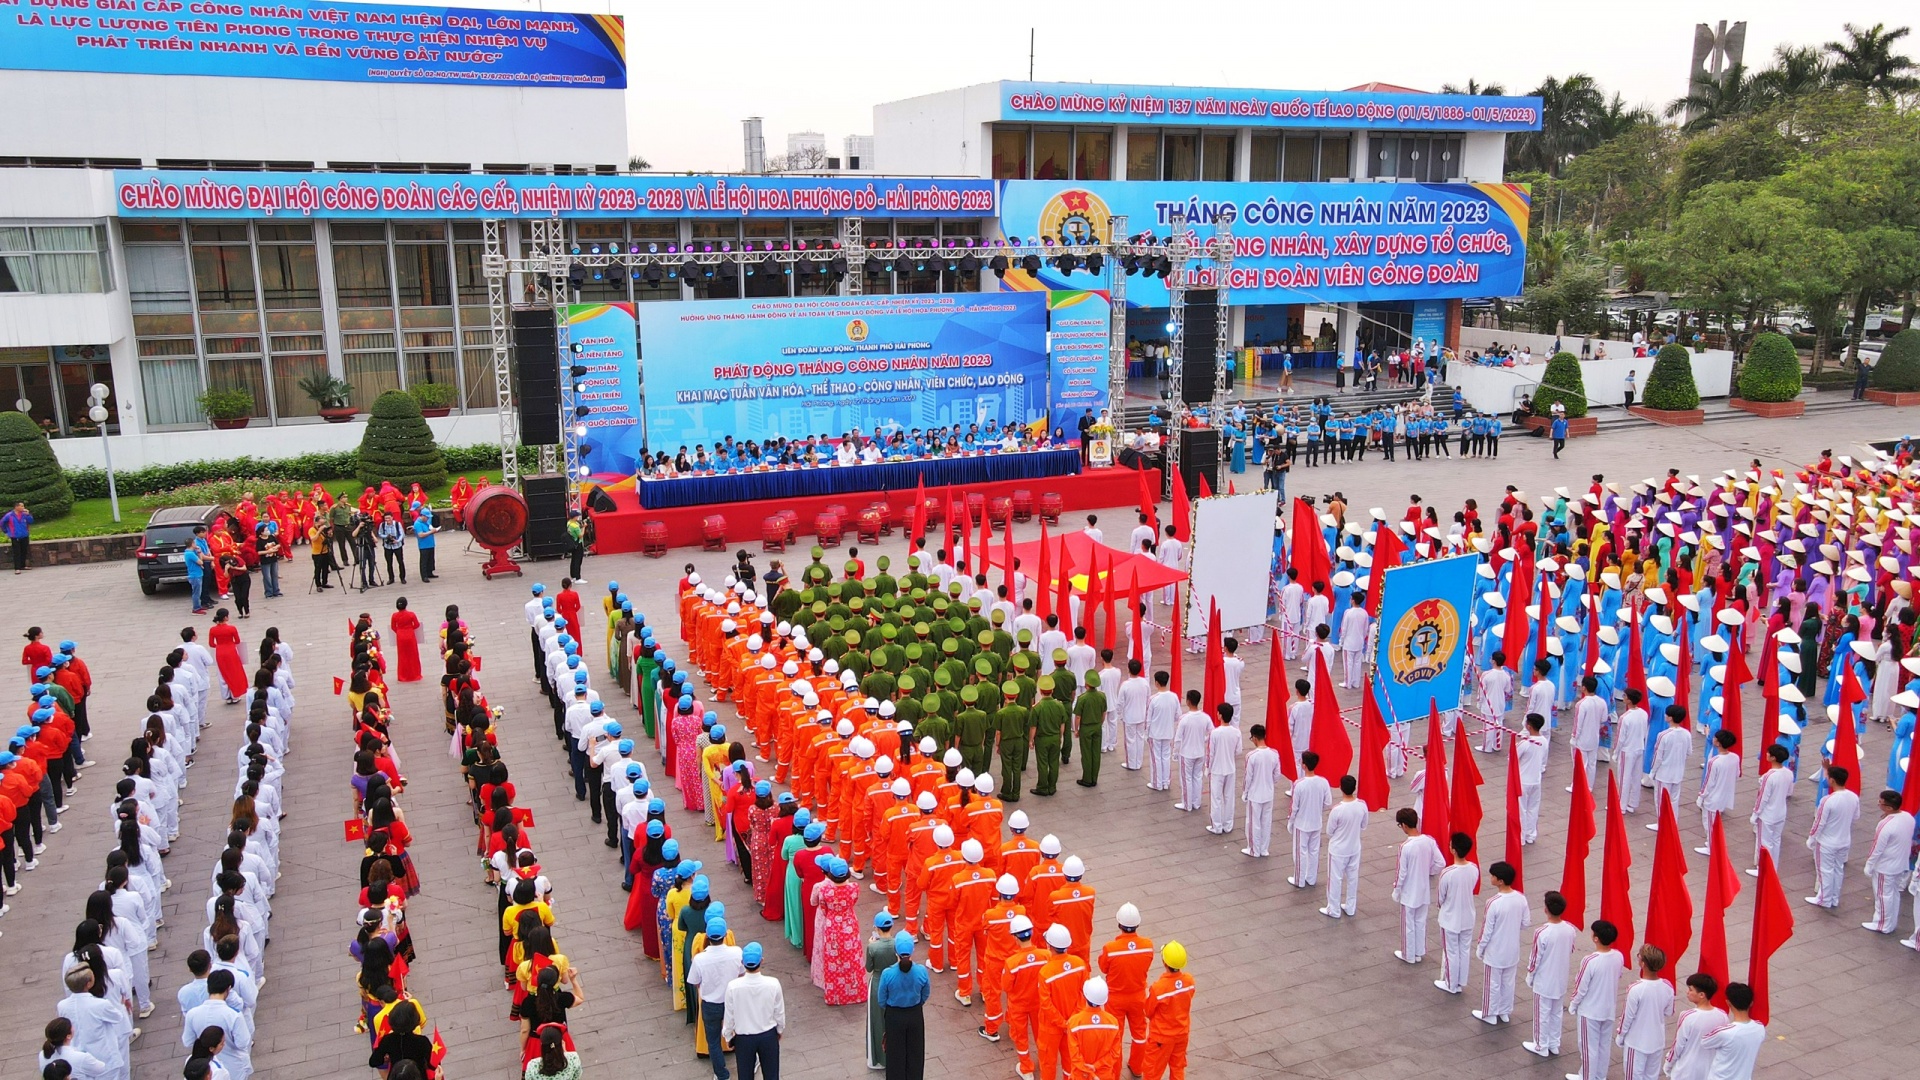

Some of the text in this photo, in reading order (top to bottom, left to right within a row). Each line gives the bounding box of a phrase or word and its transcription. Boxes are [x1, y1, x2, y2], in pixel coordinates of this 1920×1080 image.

[17, 13, 546, 50] LÀ LỰC LƯỢNG TIÊN PHONG TRONG THỰC HIỆN NHIỆM VỤ
[96, 0, 136, 11] GIAI
[189, 1, 243, 16] CÔNG
[250, 4, 302, 19] NHÂN
[308, 8, 349, 23] VIỆT
[355, 12, 395, 23] NAM
[402, 12, 441, 27] HIỆN
[447, 16, 481, 29] ĐẠI,
[487, 16, 520, 29] LỚN
[526, 20, 578, 33] MẠNH,
[76, 35, 502, 63] PHÁT TRIỂN NHANH VÀ BỀN VỮNG ĐẤT NƯỚC”
[390, 68, 412, 77] QUYẾT
[414, 68, 424, 77] SỐ
[461, 70, 478, 79] NGÀY
[1010, 90, 1536, 125] CHÀO MỪNG KỶ NIỆM 137 NĂM NGÀY QUỐC TẾ LAO ĐỘNG (01/5/1886 01/5/2023)
[120, 177, 992, 215] CHÀO MỪNG ĐẠI HỘI CÔNG ĐOÀN CÁC CẤP, NHIỆM KỲ 2023 2028 VÀ LỄ HỘI HOA PHƯỢNG ĐỎ HẢI PHÒNG 2023
[1156, 197, 1489, 226] THÁNG CÔNG NHÂN NĂM 2023
[1269, 226, 1512, 260] NHÂN, XÂY DỰNG TỔ CHỨC,
[1264, 260, 1479, 290] ĐOÀN VIÊN CÔNG ĐOÀN
[713, 354, 991, 380] PHÁT ĐỘNG THÁNG CÔNG NHÂN NĂM 2023
[676, 390, 701, 403] KHAI
[704, 389, 728, 404] MẠC
[759, 384, 779, 397] VĂN
[782, 383, 804, 396] HÓA
[812, 379, 828, 394] THỂ
[830, 382, 856, 393] THAO
[864, 378, 892, 392] CÔNG
[894, 376, 924, 391] NHÂN,
[926, 375, 945, 388] VIÊN
[947, 373, 976, 388] CHỨC,
[978, 376, 995, 386] LAO
[997, 372, 1024, 388] ĐỘNG
[1408, 669, 1432, 682] CĐVN
